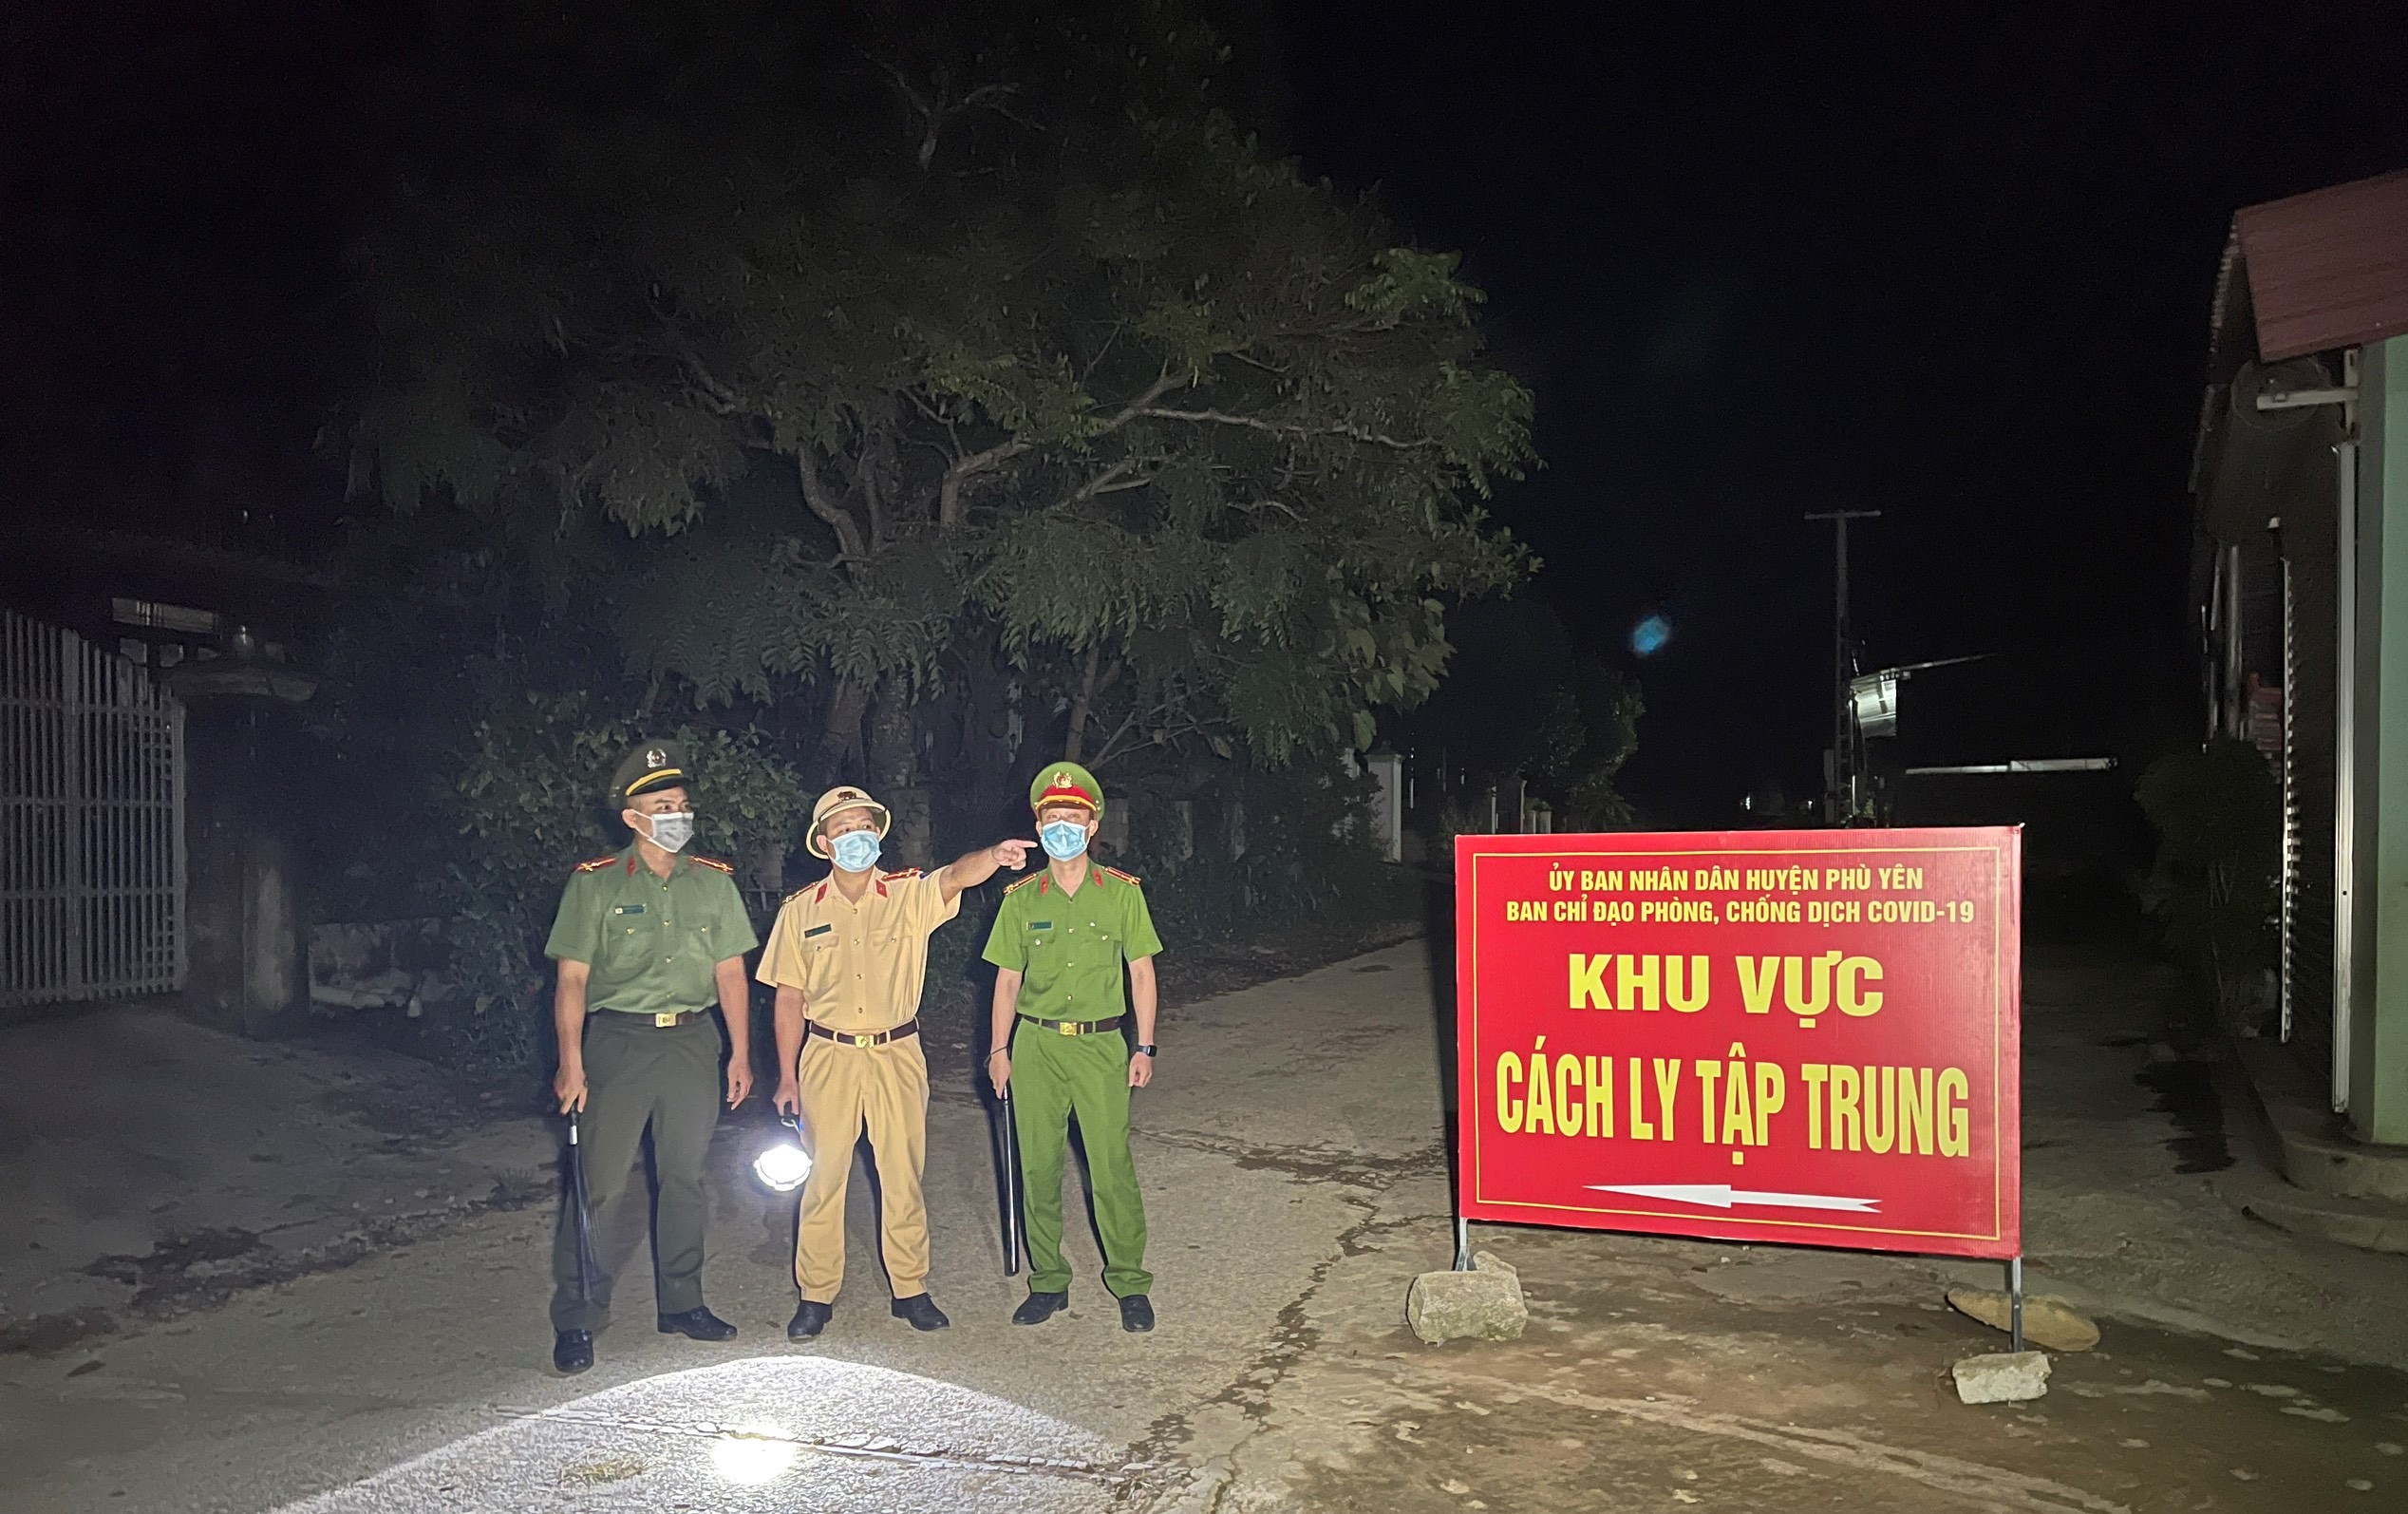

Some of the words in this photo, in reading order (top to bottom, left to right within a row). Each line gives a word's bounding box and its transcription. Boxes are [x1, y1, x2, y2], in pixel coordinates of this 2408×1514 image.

[1549, 861, 1575, 892] ỦY
[1580, 870, 1624, 891] BAN
[1629, 865, 1688, 891] NHÂN
[1695, 865, 1740, 891] DÂN
[1746, 864, 1819, 896] HUYỆN
[1825, 863, 1872, 891] PHÙ
[1878, 862, 1925, 890] YÊN
[1506, 900, 1548, 921] BAN
[1553, 893, 1588, 922] CHỈ
[1592, 900, 1635, 927] ĐẠO
[1641, 896, 1720, 925] PHÒNG,
[1725, 894, 1801, 923] CHỐNG
[1808, 900, 1861, 928] DỊCH
[1867, 899, 1975, 924] COVID-19
[1569, 953, 1710, 1013] KHU
[1735, 950, 1884, 1029] VỰC
[1496, 1034, 1614, 1139] CÁCH
[1629, 1057, 1682, 1142] LY
[1695, 1041, 1786, 1165] TẬP
[1800, 1063, 1970, 1158] TRUNG
